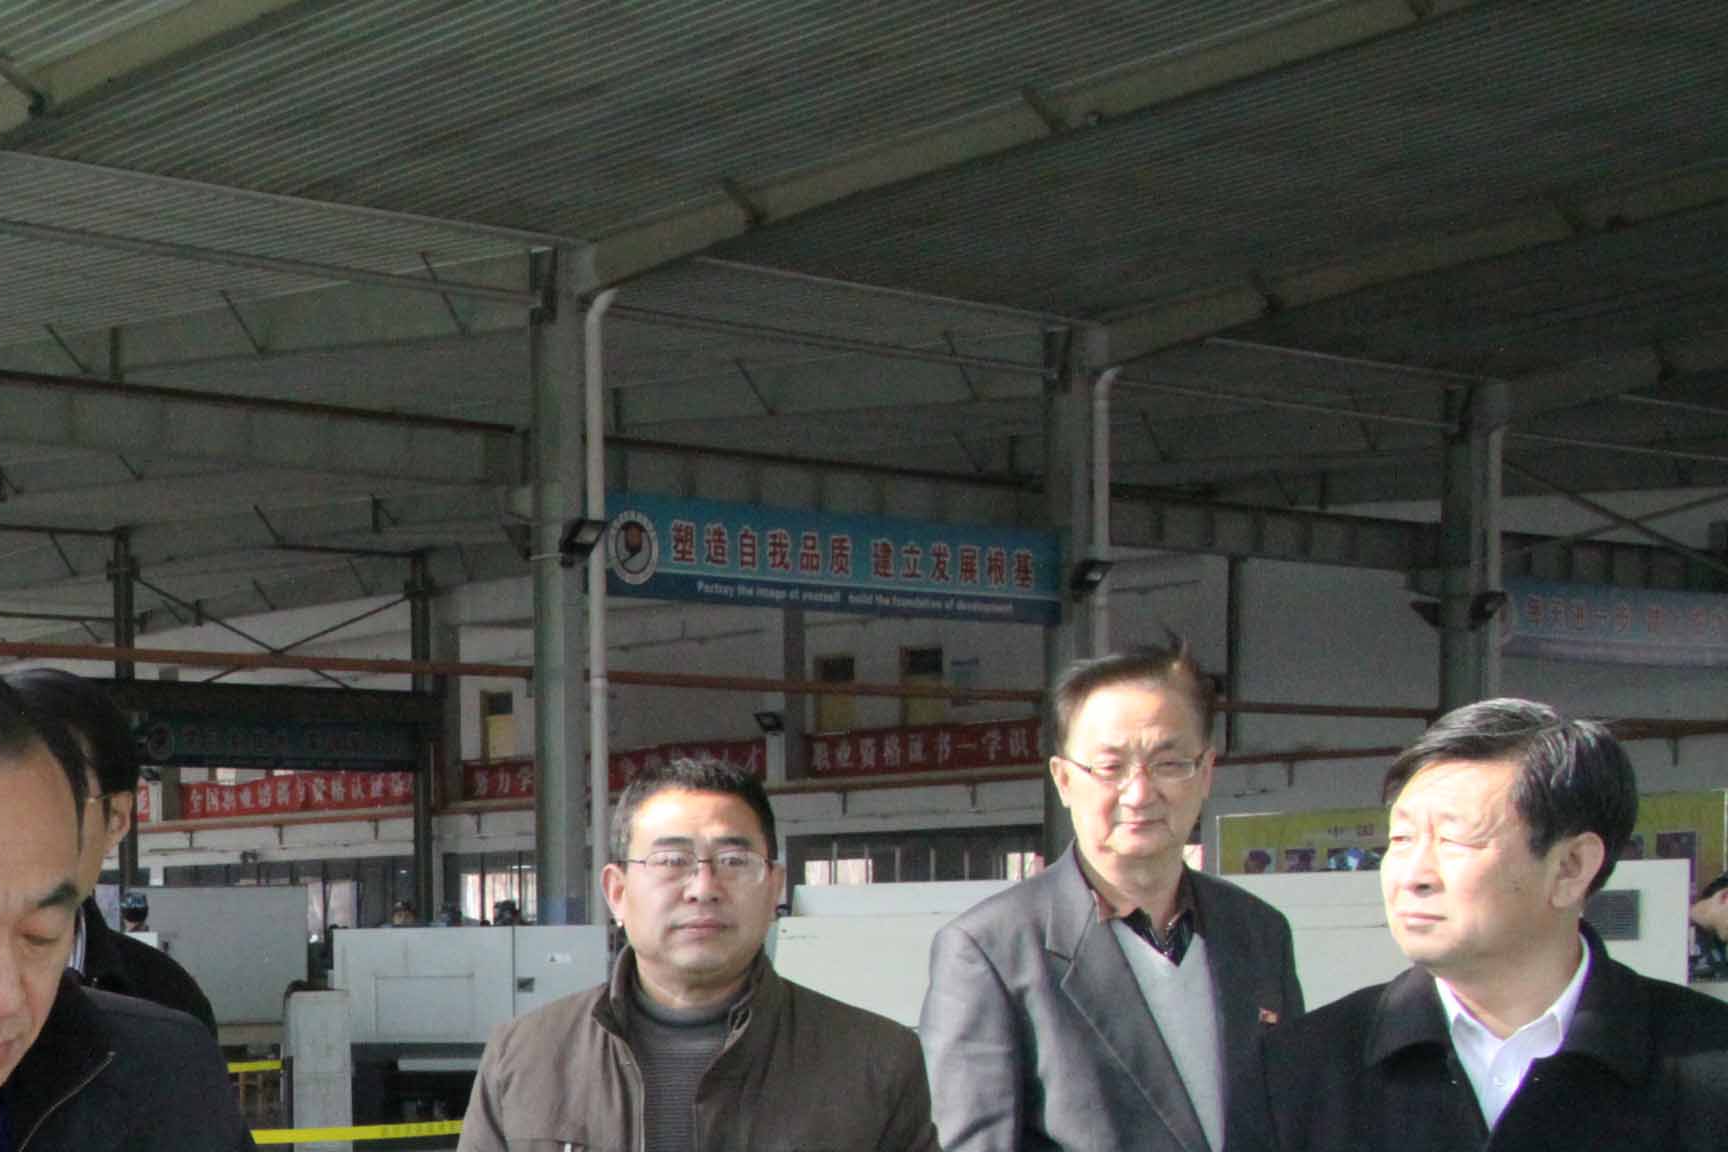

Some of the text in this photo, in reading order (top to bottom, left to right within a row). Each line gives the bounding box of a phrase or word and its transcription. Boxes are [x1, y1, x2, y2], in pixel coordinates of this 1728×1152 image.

[671, 519, 1034, 589] 塑造自我品质 建立发展根基
